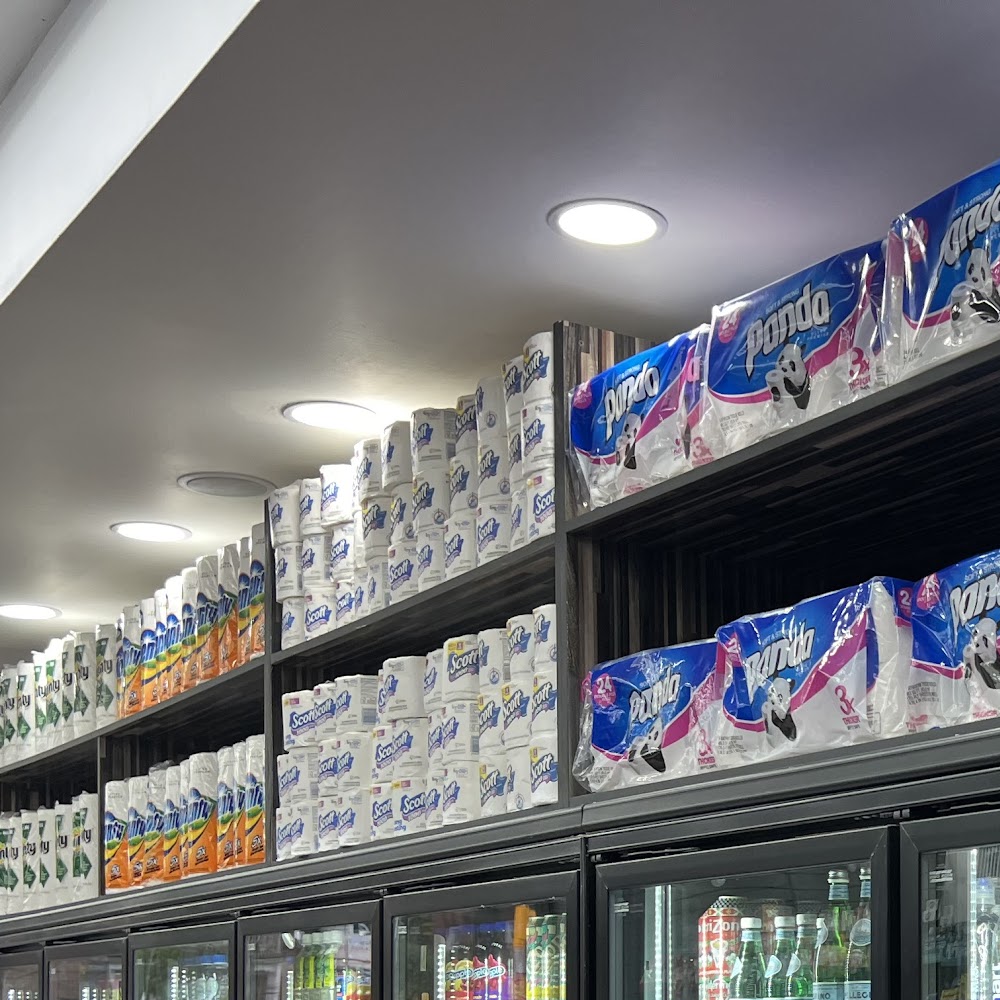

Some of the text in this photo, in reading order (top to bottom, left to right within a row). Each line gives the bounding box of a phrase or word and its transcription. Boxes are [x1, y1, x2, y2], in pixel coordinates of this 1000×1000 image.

[745, 281, 831, 383] panda
[603, 361, 660, 442] panda
[389, 559, 411, 582] Scott
[305, 605, 328, 625] Scott
[450, 650, 480, 674] Scott
[596, 675, 613, 695] 24
[291, 711, 316, 729] Scott
[531, 753, 553, 781] Scott
